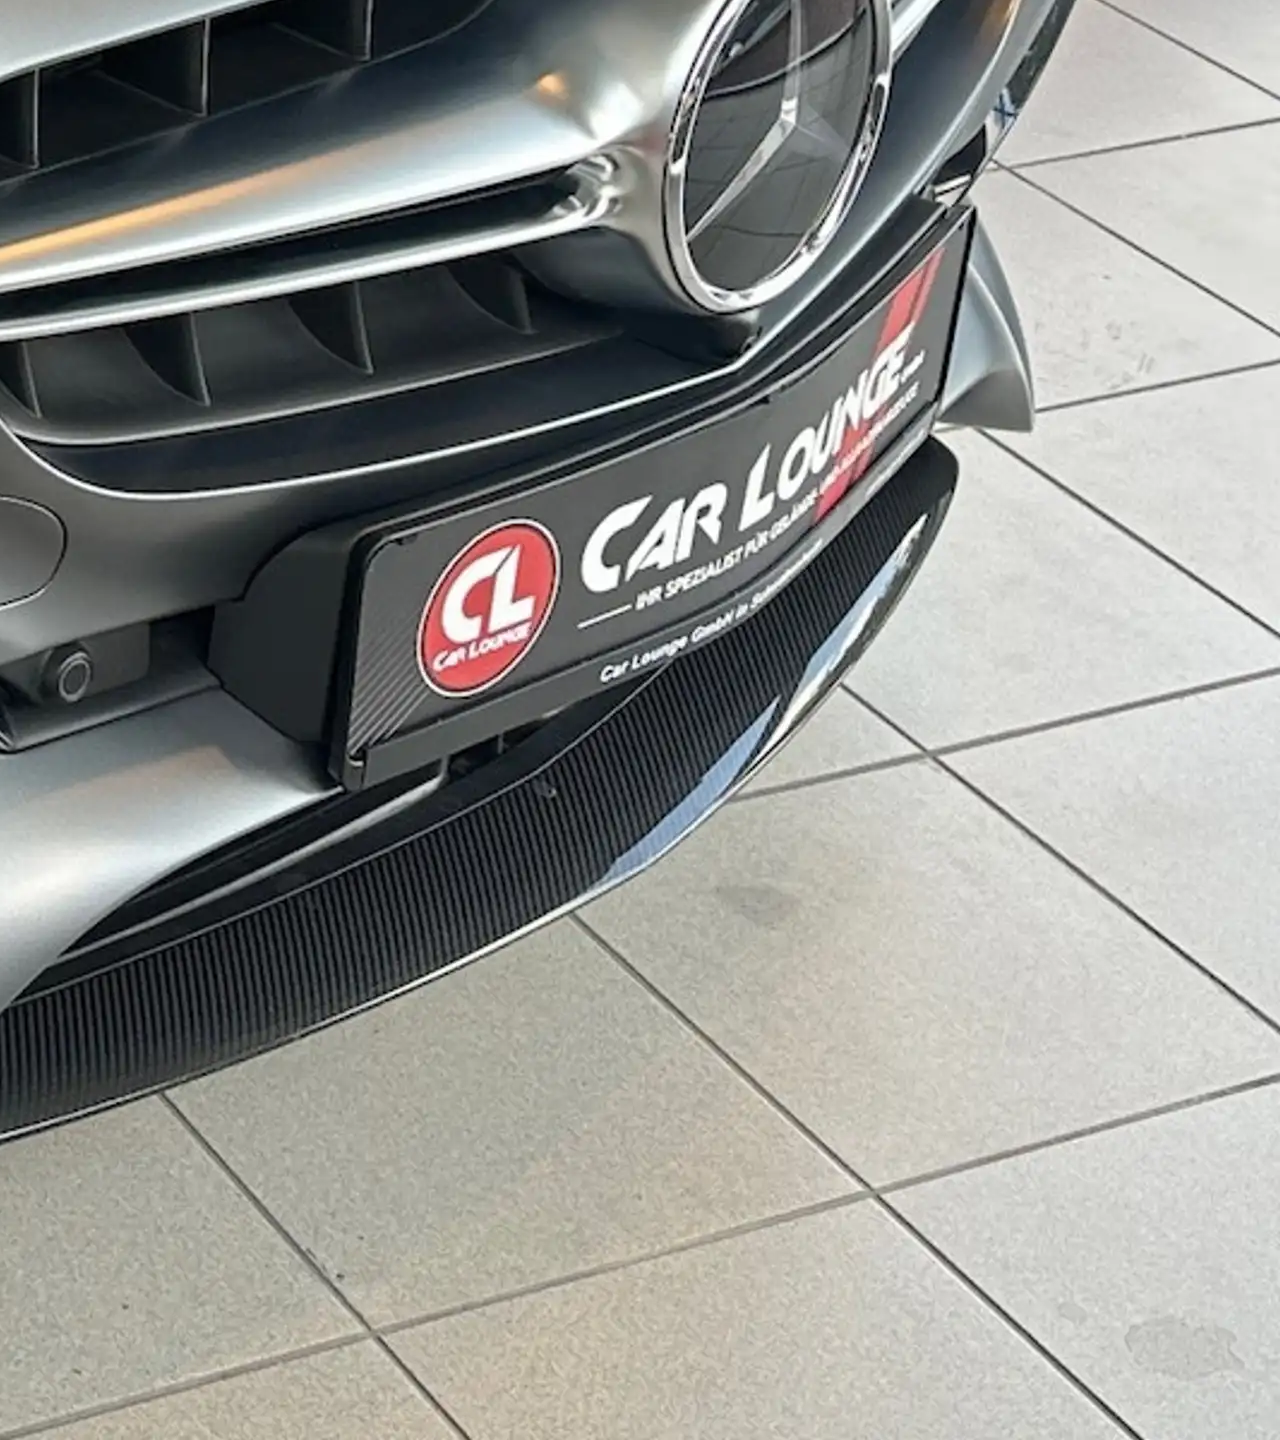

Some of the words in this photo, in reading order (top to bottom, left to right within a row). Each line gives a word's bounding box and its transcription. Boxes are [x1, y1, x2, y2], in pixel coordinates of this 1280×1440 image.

[580, 482, 728, 594] CAR
[738, 320, 917, 534] LOUNGE
[441, 543, 537, 645] CL
[635, 585, 663, 611] IHR
[663, 545, 745, 597] SPEZIALIST
[599, 660, 631, 683] Car
[631, 635, 689, 670] Lounge
[690, 608, 735, 643] GmbH
